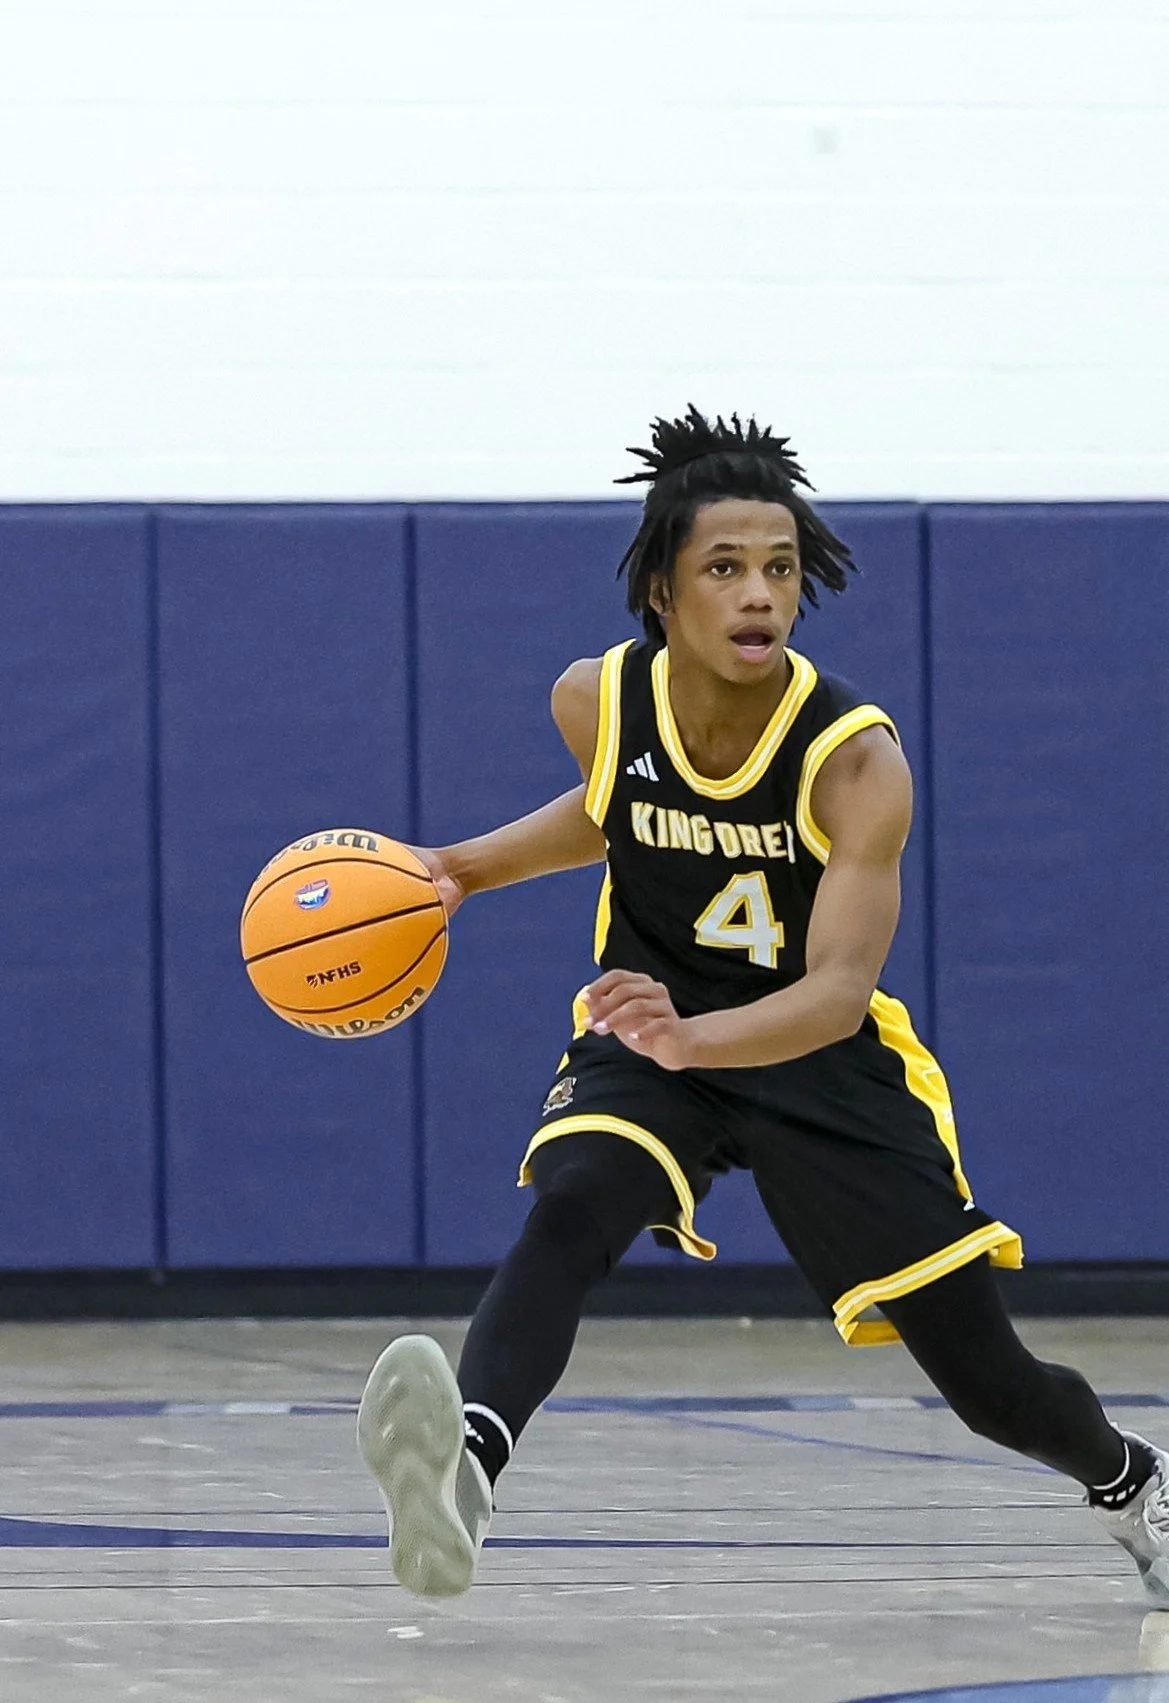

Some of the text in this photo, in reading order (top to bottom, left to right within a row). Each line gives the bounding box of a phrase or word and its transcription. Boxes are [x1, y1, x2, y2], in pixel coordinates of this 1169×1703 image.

[631, 801, 714, 856] KING
[693, 870, 785, 970] 4
[318, 961, 362, 985] NFHS
